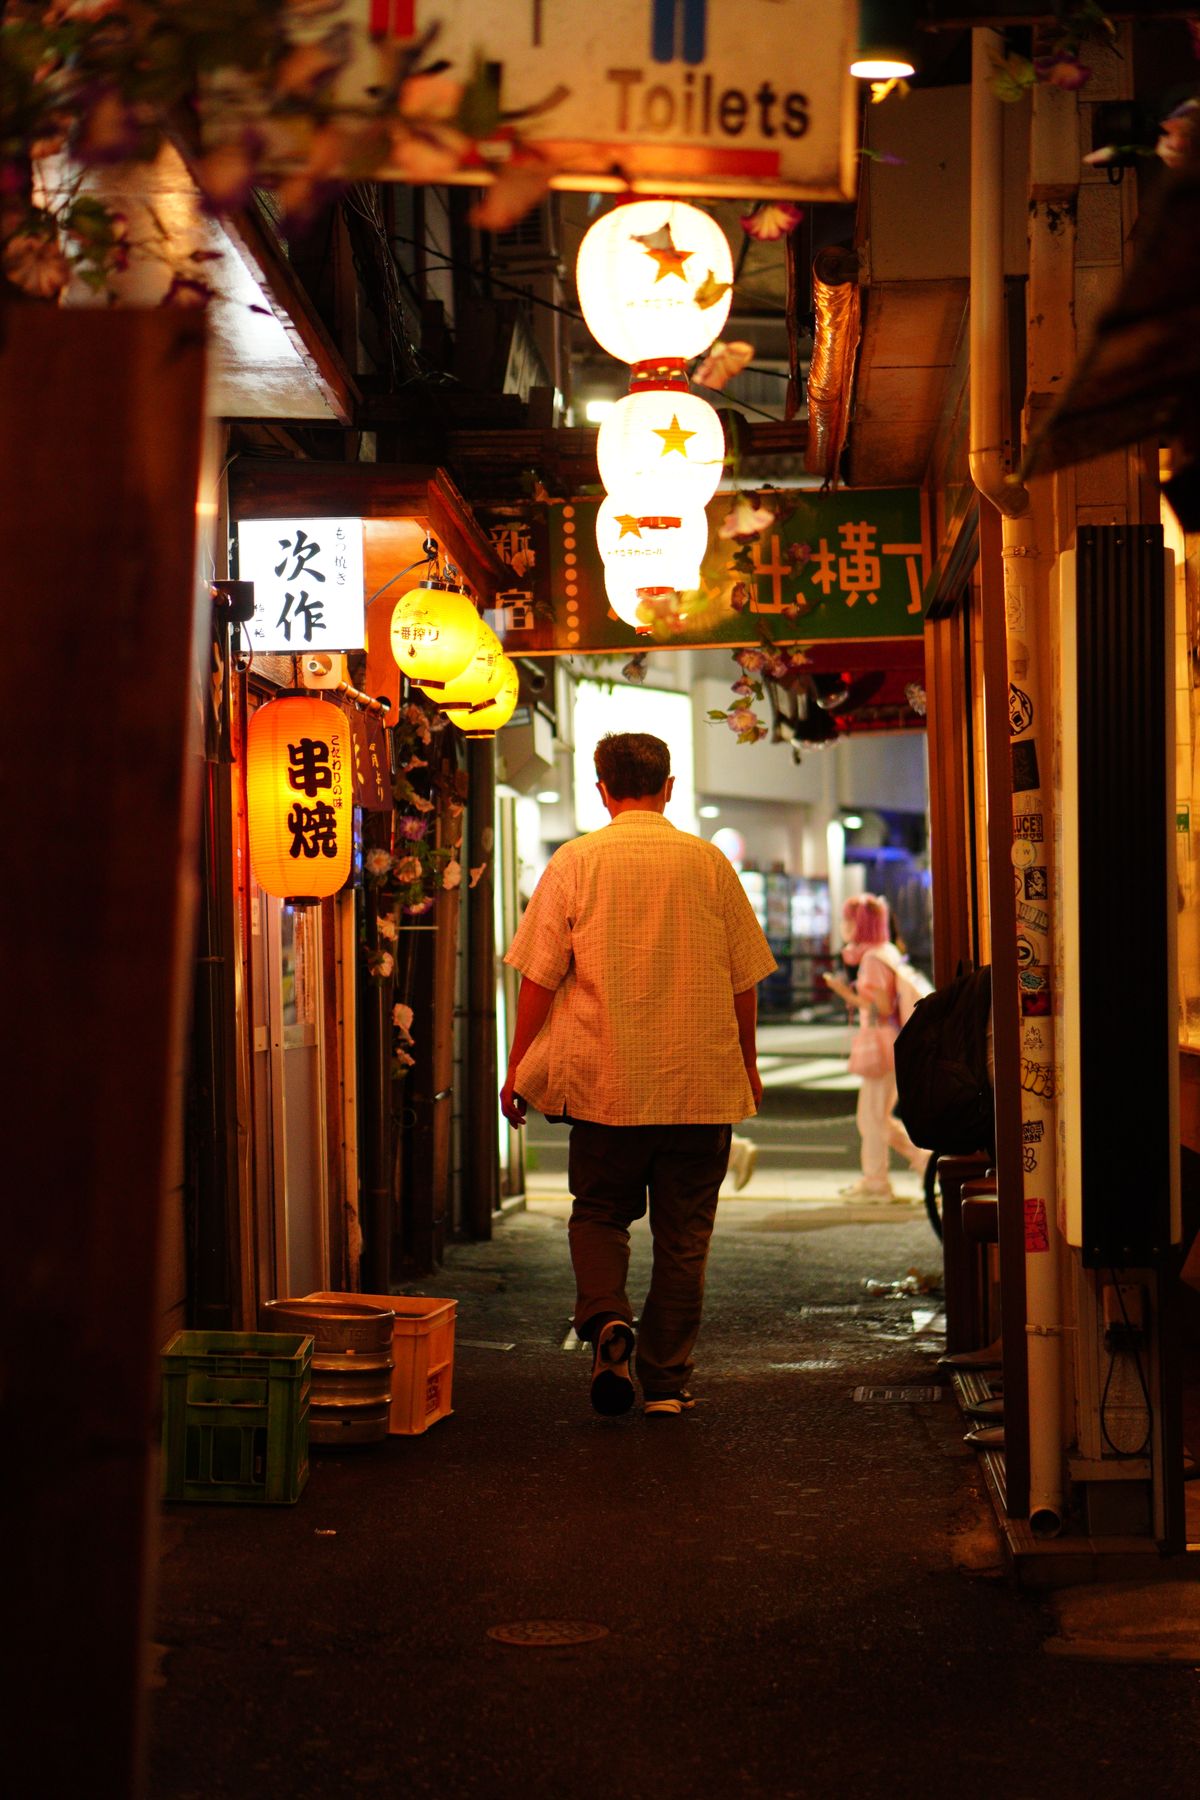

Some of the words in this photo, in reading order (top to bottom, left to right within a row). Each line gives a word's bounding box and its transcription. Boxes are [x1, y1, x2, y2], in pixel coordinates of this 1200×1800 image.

[606, 68, 810, 139] Toilets
[274, 529, 326, 642] 次作
[393, 626, 439, 641] 一番搾り
[287, 738, 338, 859] 串焼
[331, 735, 343, 809] こだわりの味
